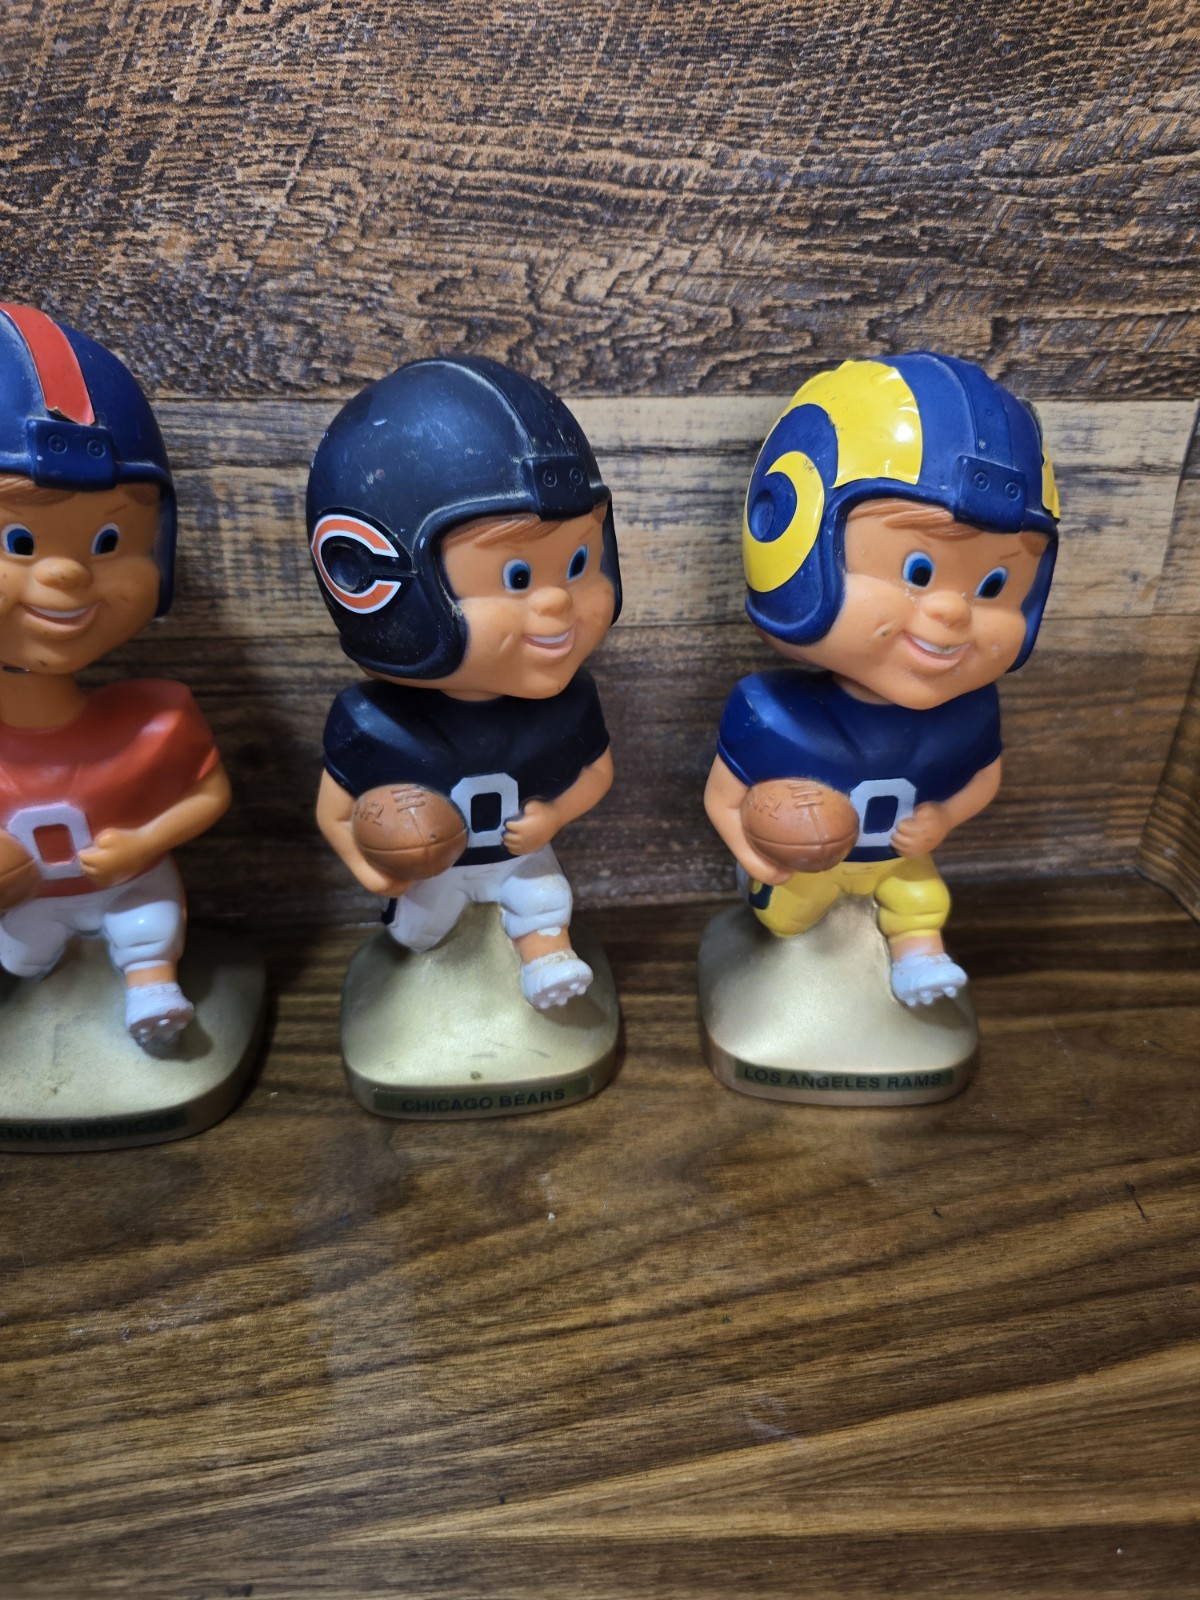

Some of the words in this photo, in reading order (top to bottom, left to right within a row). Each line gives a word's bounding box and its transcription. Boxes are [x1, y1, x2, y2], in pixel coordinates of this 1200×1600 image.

[311, 514, 402, 615] C
[354, 801, 385, 826] NFL
[750, 792, 783, 821] NFL
[744, 1066, 781, 1085] LOS
[787, 1072, 880, 1089] ANGELES
[887, 1072, 942, 1089] RAMS
[402, 1096, 494, 1113] CHICAGO
[500, 1088, 565, 1107] BEARS
[0, 1126, 65, 1140] ENVER
[70, 1114, 180, 1139] BRONCOS
